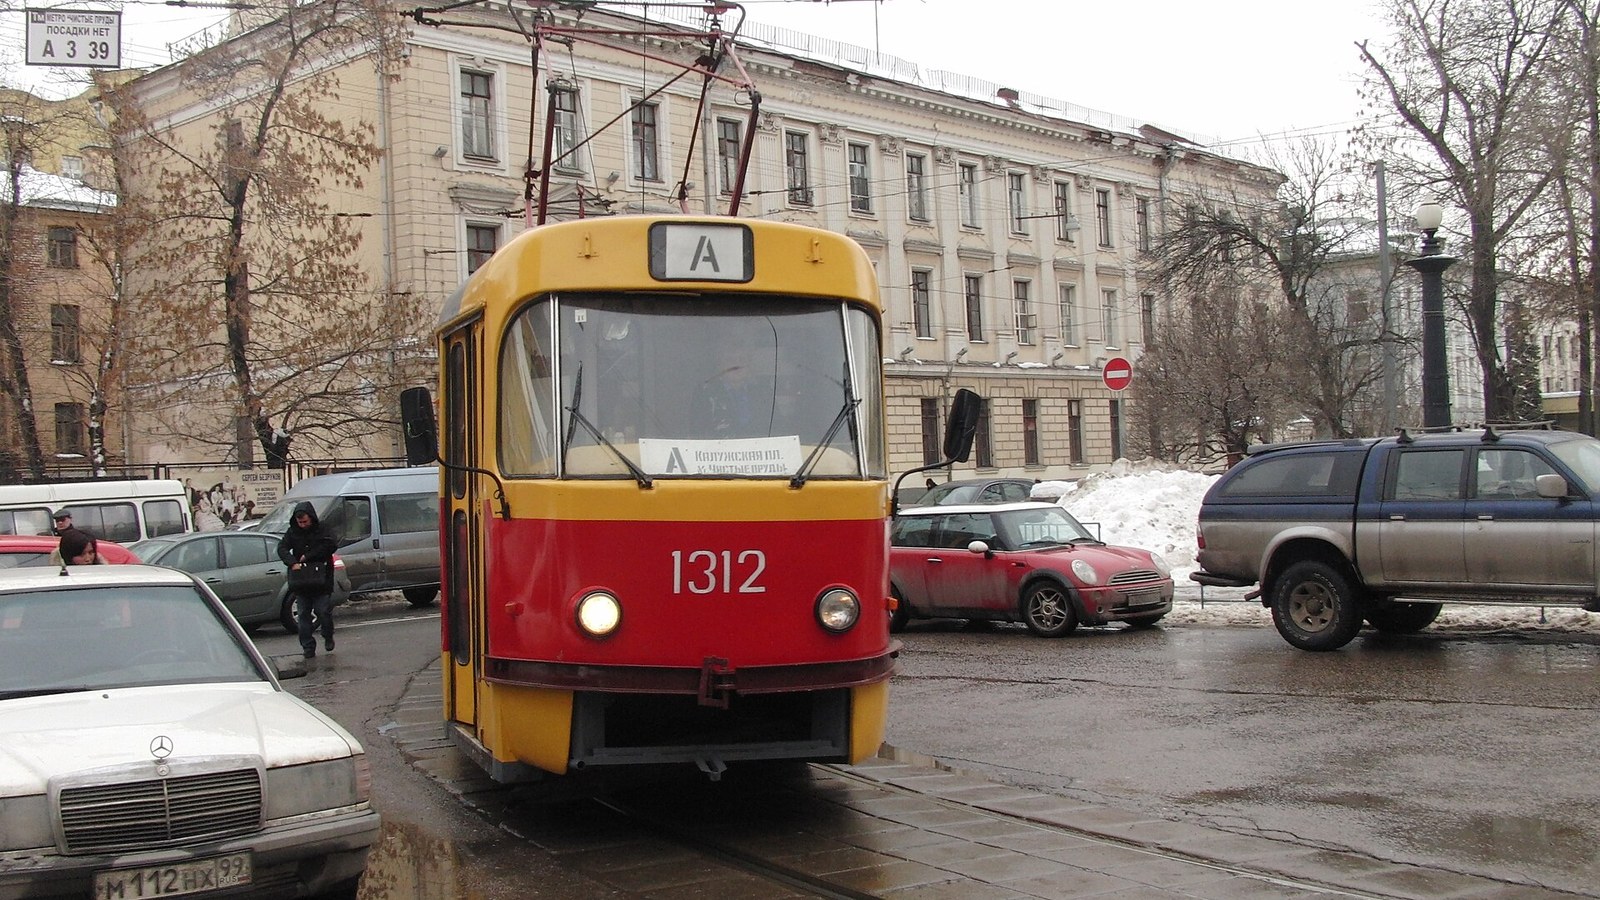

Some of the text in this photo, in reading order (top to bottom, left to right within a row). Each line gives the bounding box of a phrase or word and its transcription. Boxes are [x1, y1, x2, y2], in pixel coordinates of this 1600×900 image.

[47, 13, 66, 22] МЕТРО
[46, 25, 110, 37] ПОСАДКИ НЕТ
[42, 39, 109, 60] А 3 39
[689, 235, 720, 273] А
[665, 447, 689, 473] А
[671, 549, 766, 594] 1312
[219, 857, 243, 877] 99
[218, 876, 238, 885] RUS
